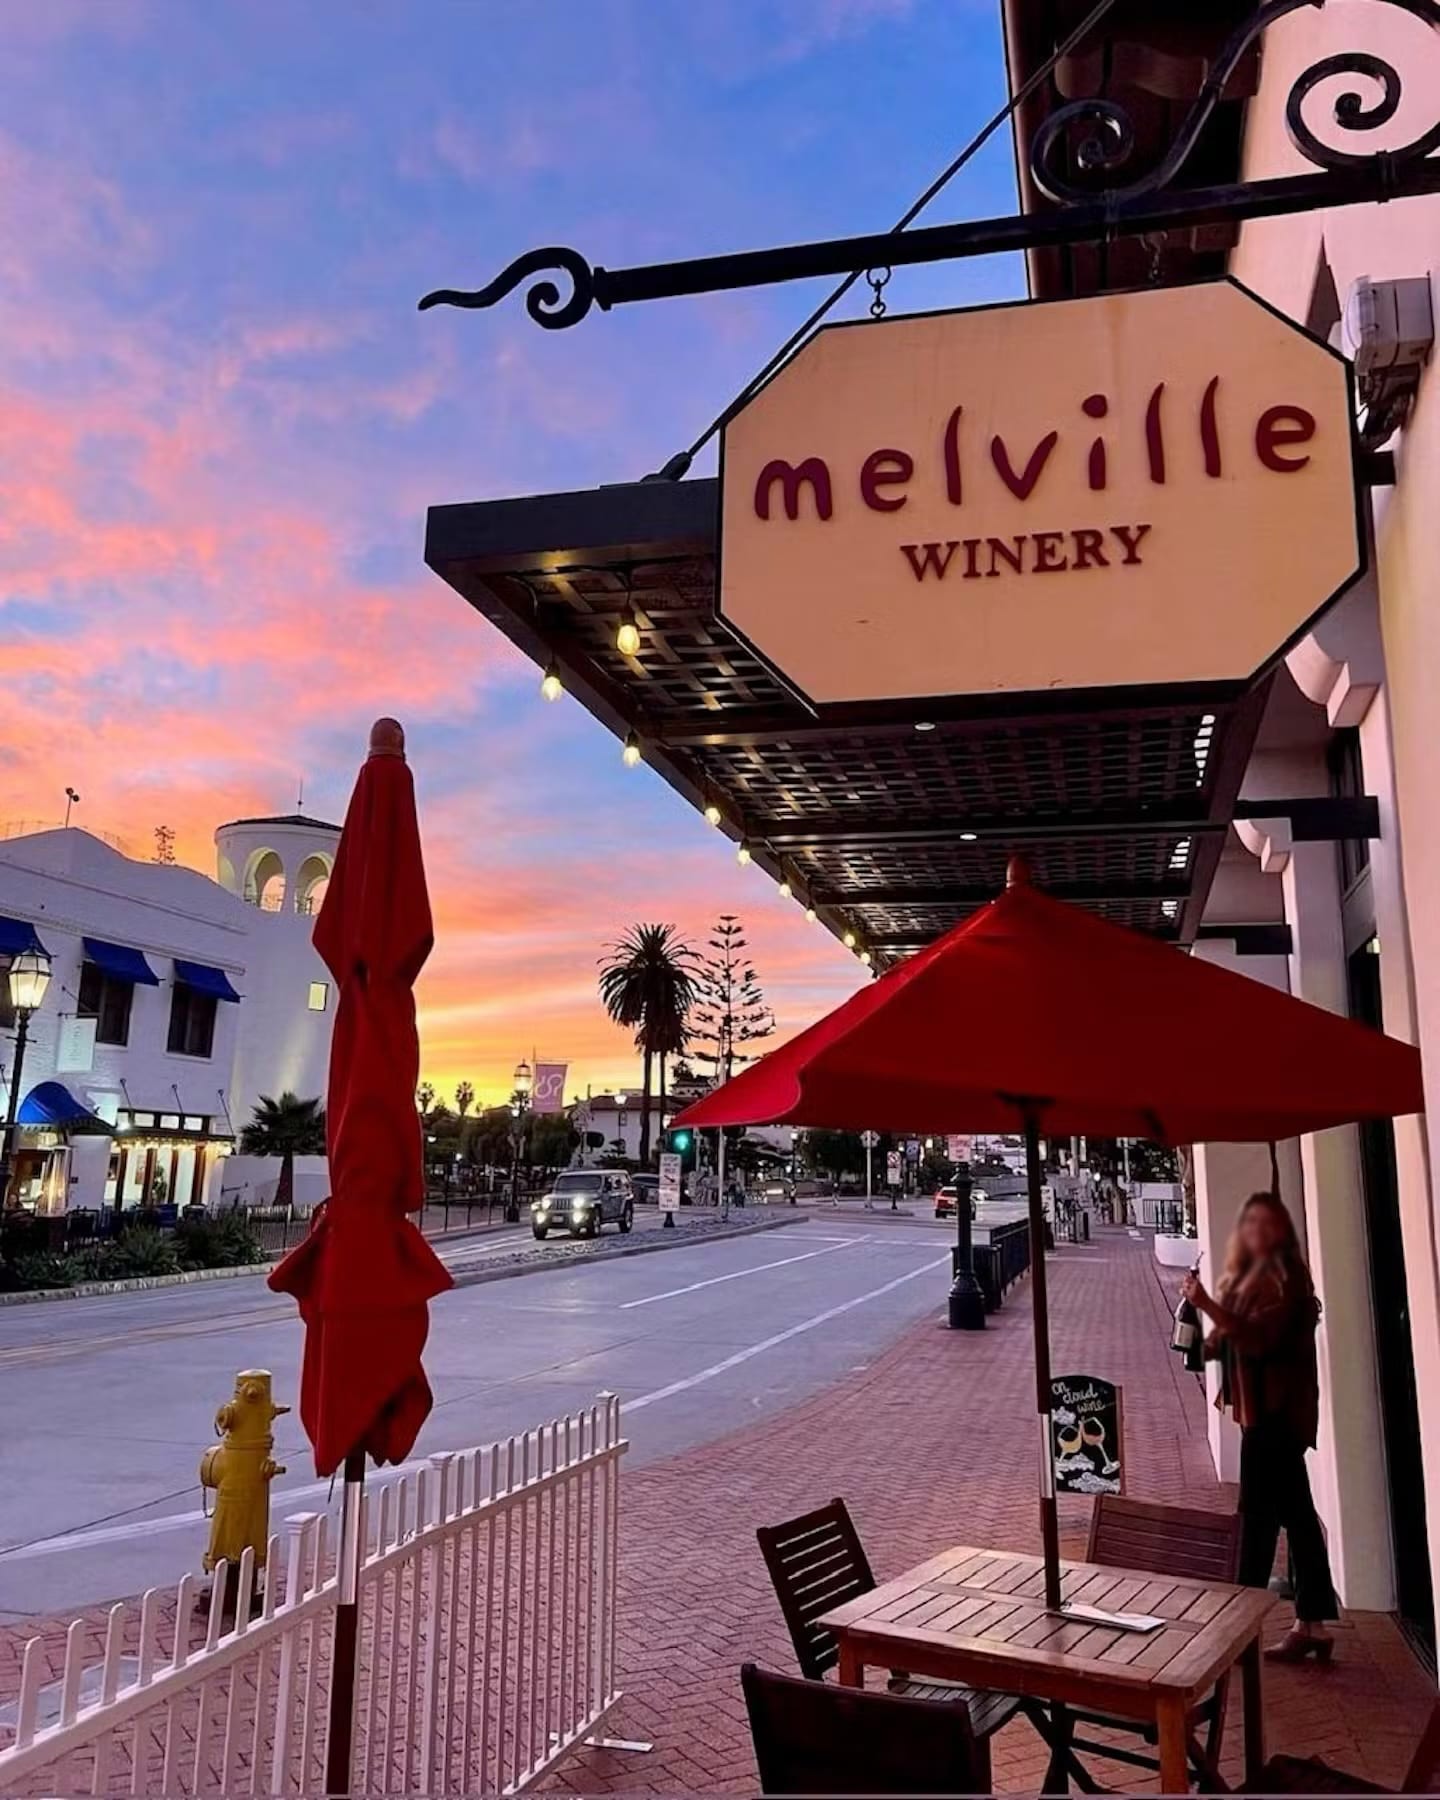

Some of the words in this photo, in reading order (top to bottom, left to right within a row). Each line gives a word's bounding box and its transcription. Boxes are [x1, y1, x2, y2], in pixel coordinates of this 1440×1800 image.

[754, 375, 1316, 521] melville
[900, 524, 1152, 582] WINERY
[1062, 1383, 1098, 1404] cloud
[1077, 1400, 1105, 1414] wine
